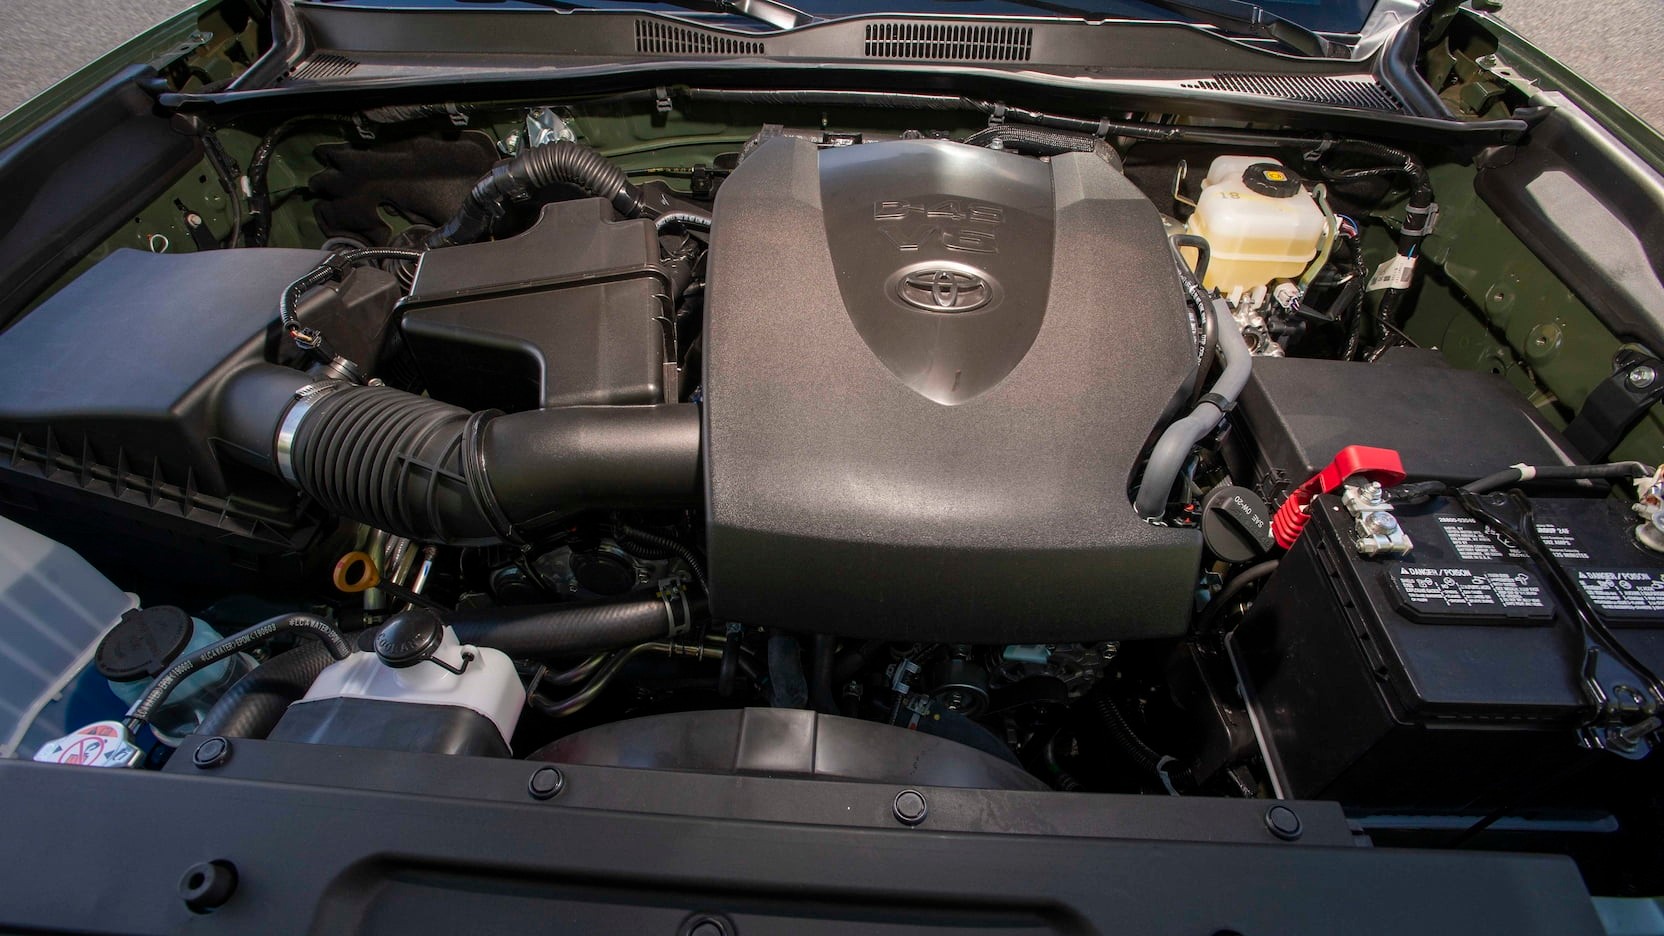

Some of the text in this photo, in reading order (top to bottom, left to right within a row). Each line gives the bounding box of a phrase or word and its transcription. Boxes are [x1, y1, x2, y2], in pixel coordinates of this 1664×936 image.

[877, 224, 1000, 254] V6
[1234, 495, 1265, 529] SAE 0W-20
[1408, 567, 1439, 576] DANGER
[1443, 569, 1473, 577] POISON
[1586, 572, 1617, 580] DANGER
